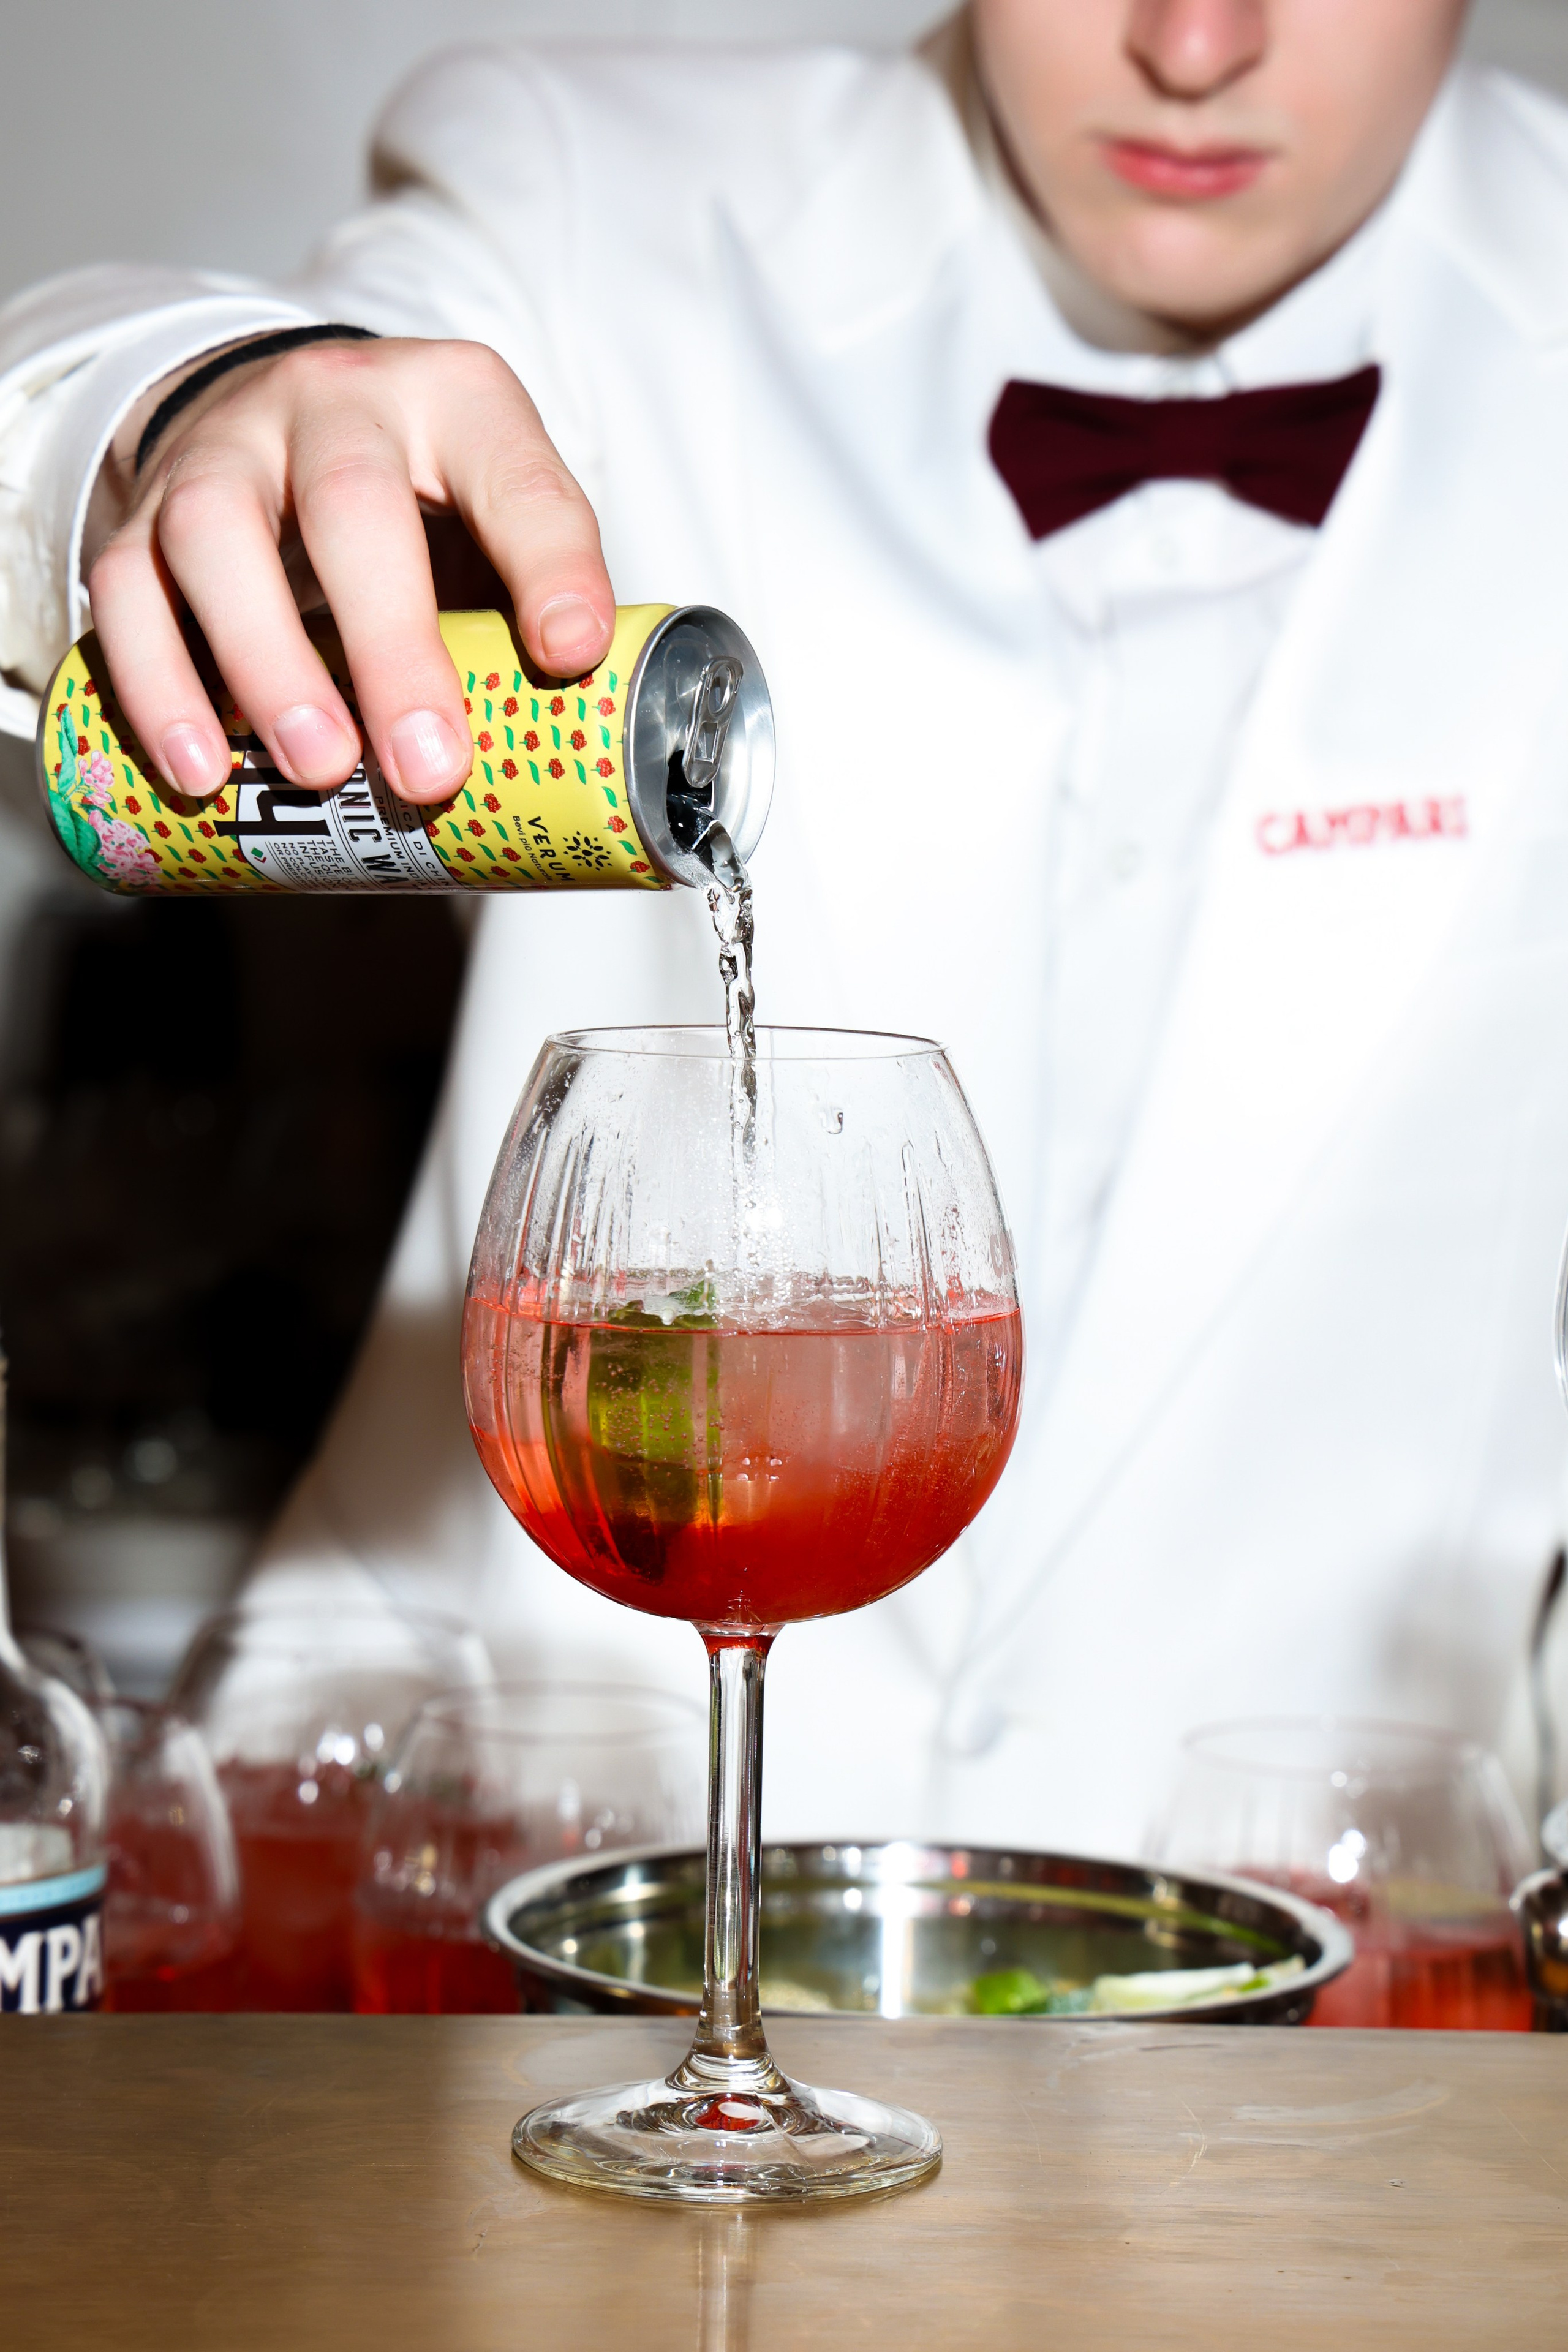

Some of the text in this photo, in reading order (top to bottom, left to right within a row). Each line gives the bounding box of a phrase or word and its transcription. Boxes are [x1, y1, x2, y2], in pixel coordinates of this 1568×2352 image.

[337, 768, 382, 843] ONIC
[375, 796, 405, 859] PREMIUM
[513, 815, 526, 835] Bevi
[274, 842, 284, 855] OR
[281, 842, 292, 856] NO
[288, 842, 299, 856] NO
[307, 840, 325, 862] THE
[317, 840, 344, 875] TASTE
[326, 840, 345, 864] THE
[413, 841, 427, 855] DI
[527, 815, 576, 881] VERUM
[297, 842, 340, 888] INFUSION
